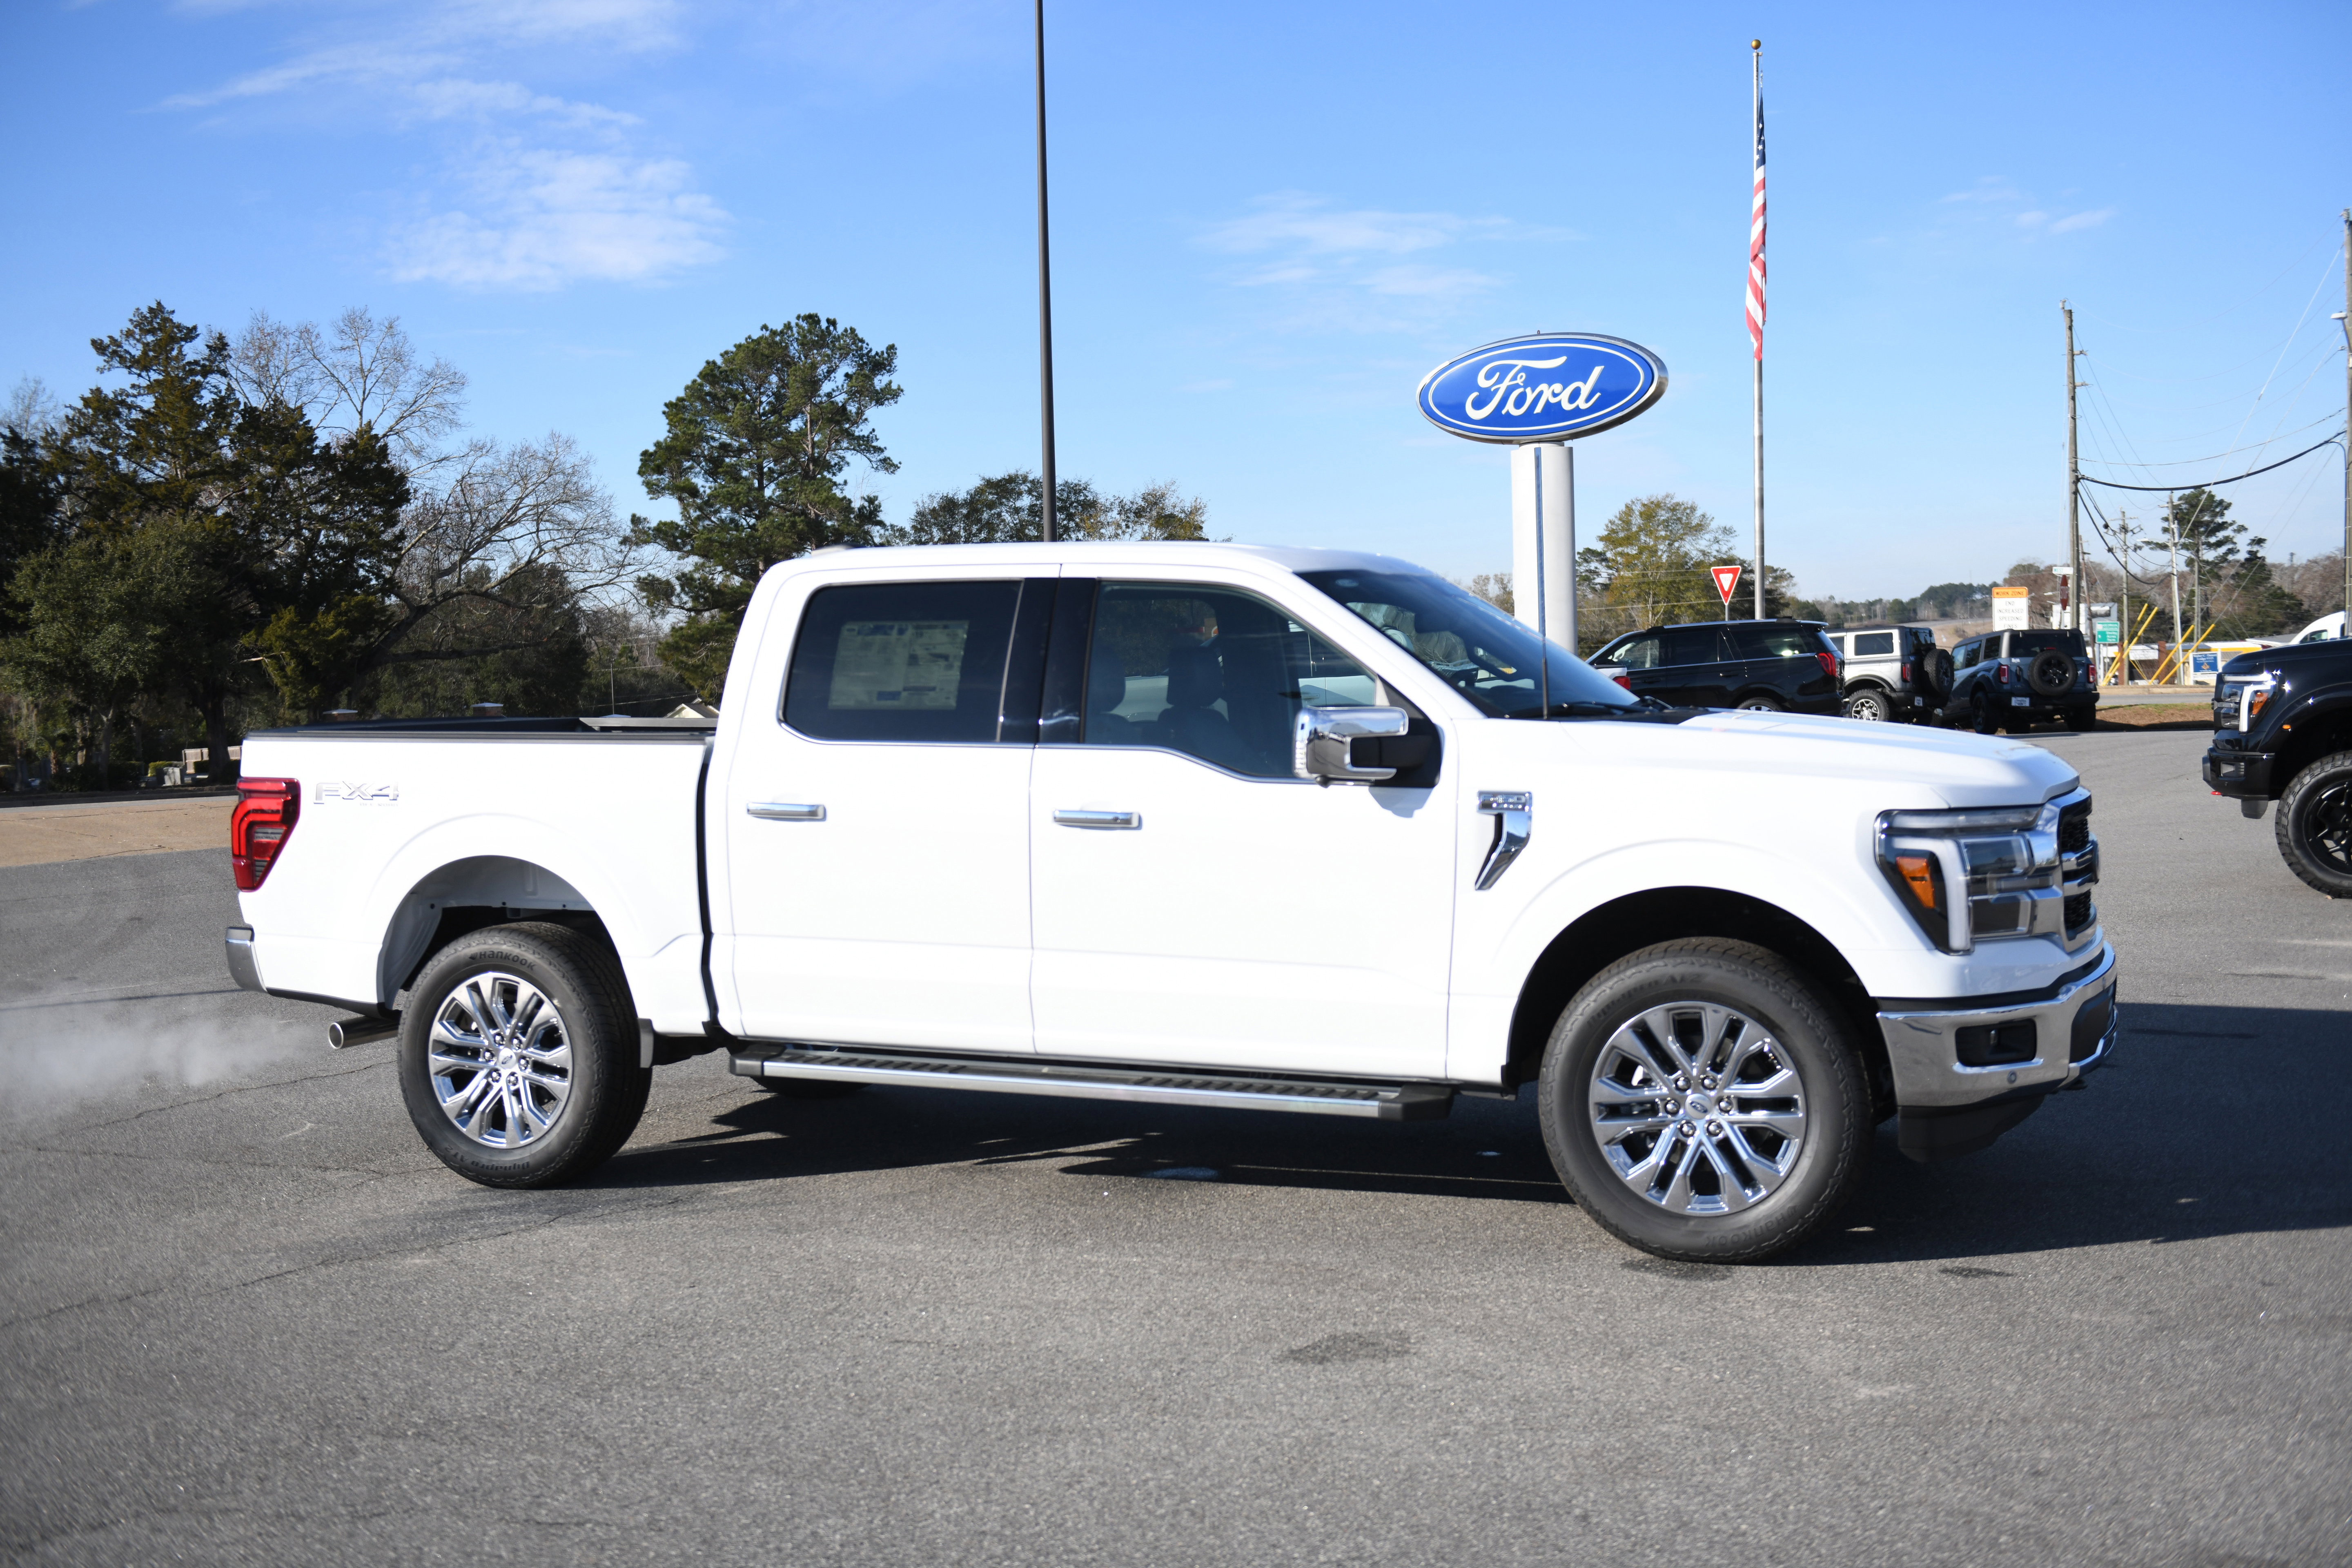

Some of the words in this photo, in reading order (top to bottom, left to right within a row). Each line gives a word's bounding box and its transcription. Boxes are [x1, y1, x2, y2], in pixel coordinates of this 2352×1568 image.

[1465, 356, 1605, 420] Ford
[314, 781, 399, 804] FX4
[471, 1160, 530, 1171] Dynapro
